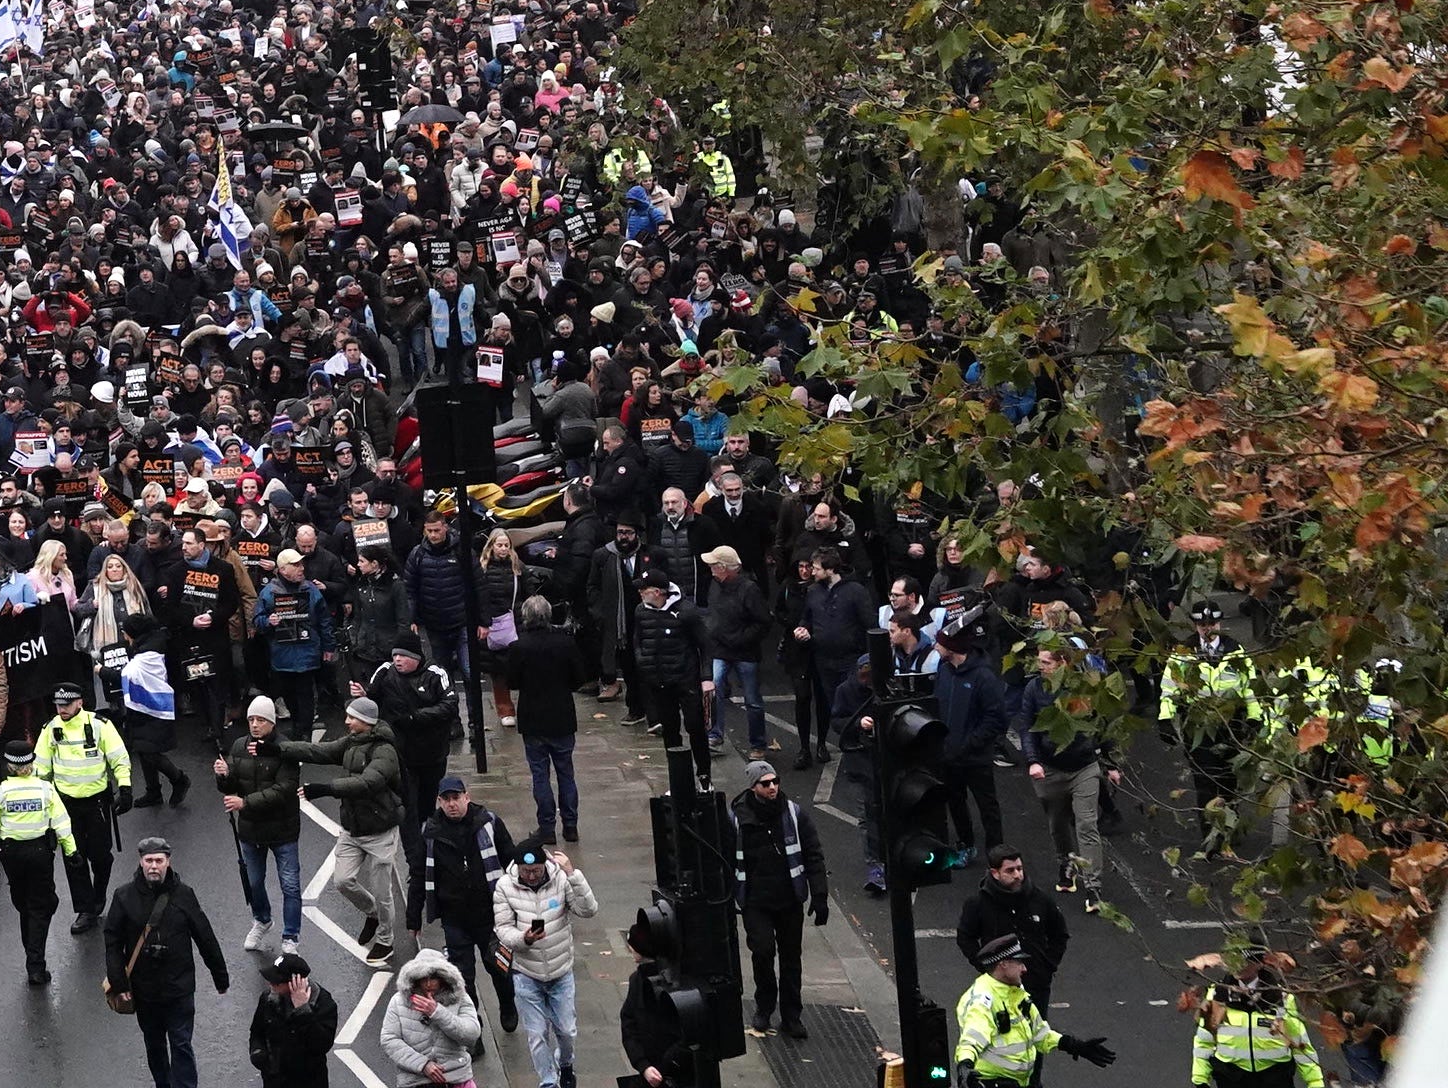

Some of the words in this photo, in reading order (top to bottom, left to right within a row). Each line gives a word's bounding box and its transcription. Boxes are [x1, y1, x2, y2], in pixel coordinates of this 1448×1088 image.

[478, 219, 499, 228] NEVER
[499, 216, 513, 224] AGA
[125, 368, 146, 376] NEVER
[125, 375, 147, 383] AGAIN
[127, 390, 148, 398] NOW!
[641, 418, 670, 430] ZERO
[296, 452, 320, 462] ACT
[143, 459, 173, 470] ACT
[213, 466, 243, 477] ZERO
[56, 482, 87, 492] ZERO
[353, 521, 386, 533] ZERO
[239, 542, 270, 553] ZERO
[356, 538, 389, 547] ANTISEMITES
[186, 570, 220, 585] ZERO
[183, 589, 217, 599] ANTISEMITES
[940, 595, 965, 605] KINGDOM
[103, 647, 127, 660] NEVER
[104, 656, 130, 668] AGAIN
[7, 802, 41, 812] POLICE
